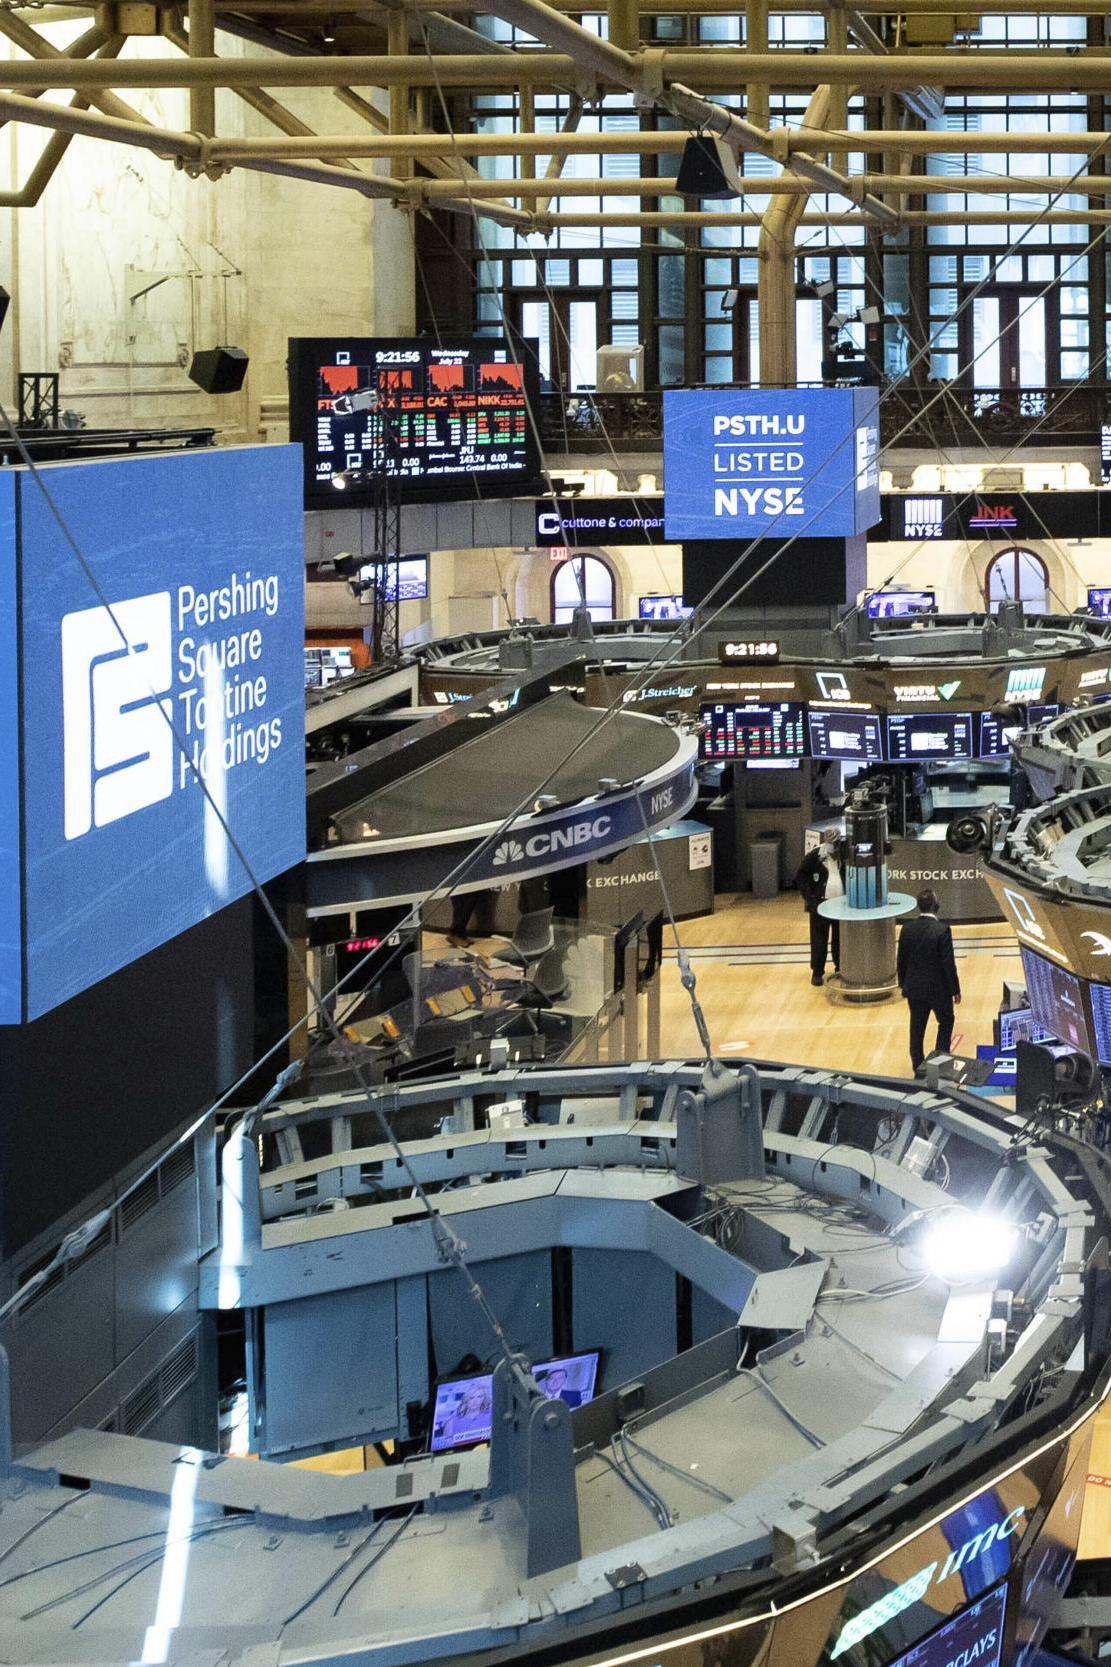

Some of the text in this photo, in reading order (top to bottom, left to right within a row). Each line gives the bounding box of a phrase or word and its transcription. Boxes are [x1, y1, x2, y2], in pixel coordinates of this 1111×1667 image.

[375, 351, 420, 363] 9:21:56
[431, 350, 469, 358] Wednesday
[427, 397, 447, 407] CAC
[477, 395, 501, 405] NIKK
[714, 414, 805, 435] PSTH.U
[402, 457, 420, 467] 0.00
[491, 454, 507, 463] 0.00
[714, 452, 804, 473] LISTED
[714, 487, 805, 516] NYSE
[561, 518, 606, 528] cuttone
[608, 517, 616, 528] &
[619, 518, 665, 530] compan
[904, 524, 943, 537] NYSE
[178, 571, 279, 631] Pershing
[178, 628, 262, 684] Square
[725, 643, 777, 656] 9:21:56
[638, 685, 698, 700] J.Streicher
[894, 685, 936, 696] VIRTU
[178, 675, 267, 736] Totine
[180, 717, 282, 790] Hodings
[525, 786, 674, 858] CNBC NYSE
[595, 870, 662, 888] EXCHANGE
[887, 869, 984, 881] ORK STOCK EXCH
[1087, 1475, 1103, 1483] DO
[945, 1628, 998, 1667] CLAYS
